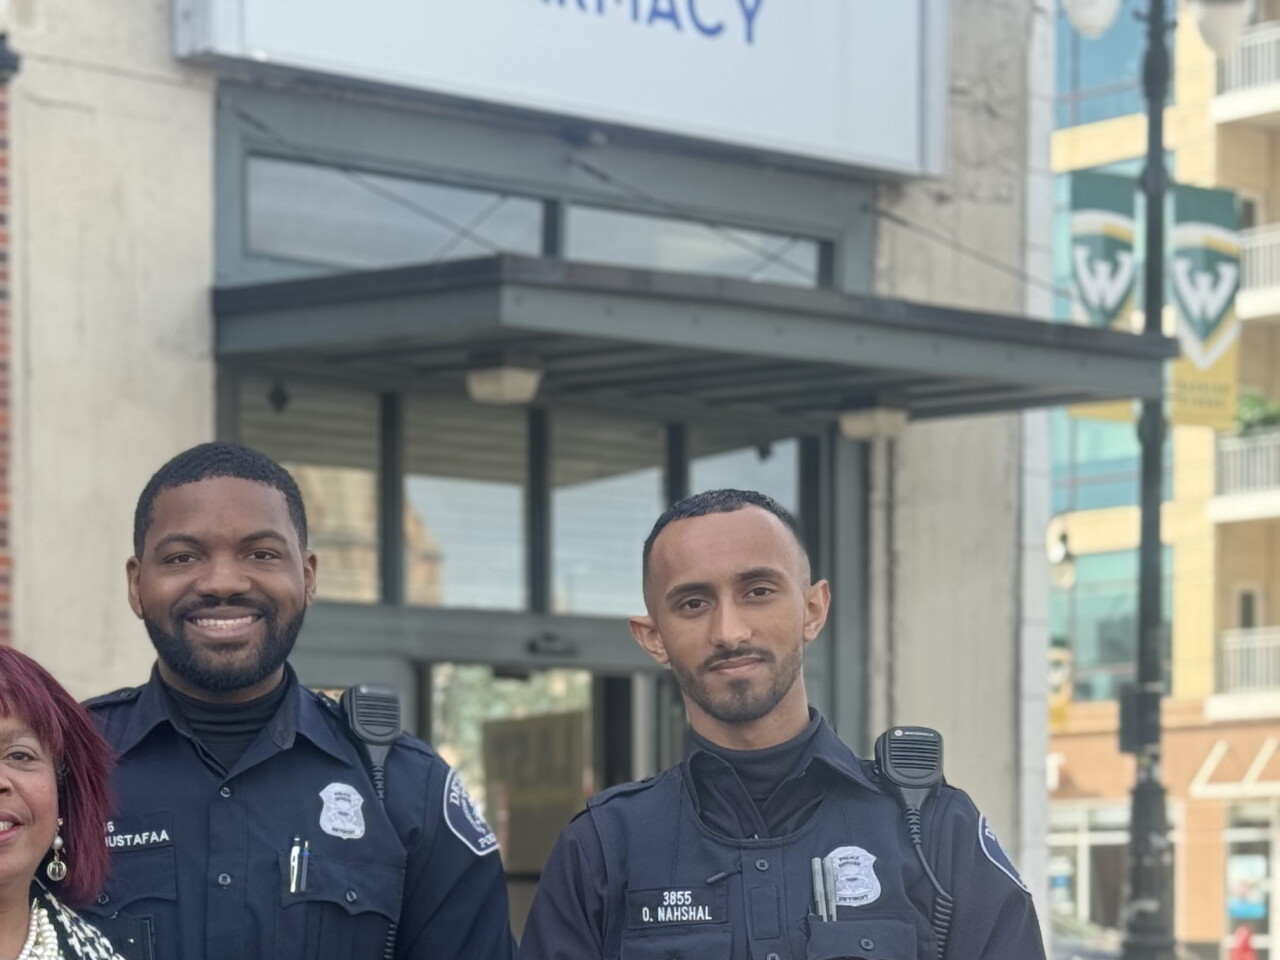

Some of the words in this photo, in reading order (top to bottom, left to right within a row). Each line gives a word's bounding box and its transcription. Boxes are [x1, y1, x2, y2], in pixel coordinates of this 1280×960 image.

[1174, 258, 1238, 322] W
[663, 891, 692, 906] 3855
[658, 905, 713, 922] NAHSHAL
